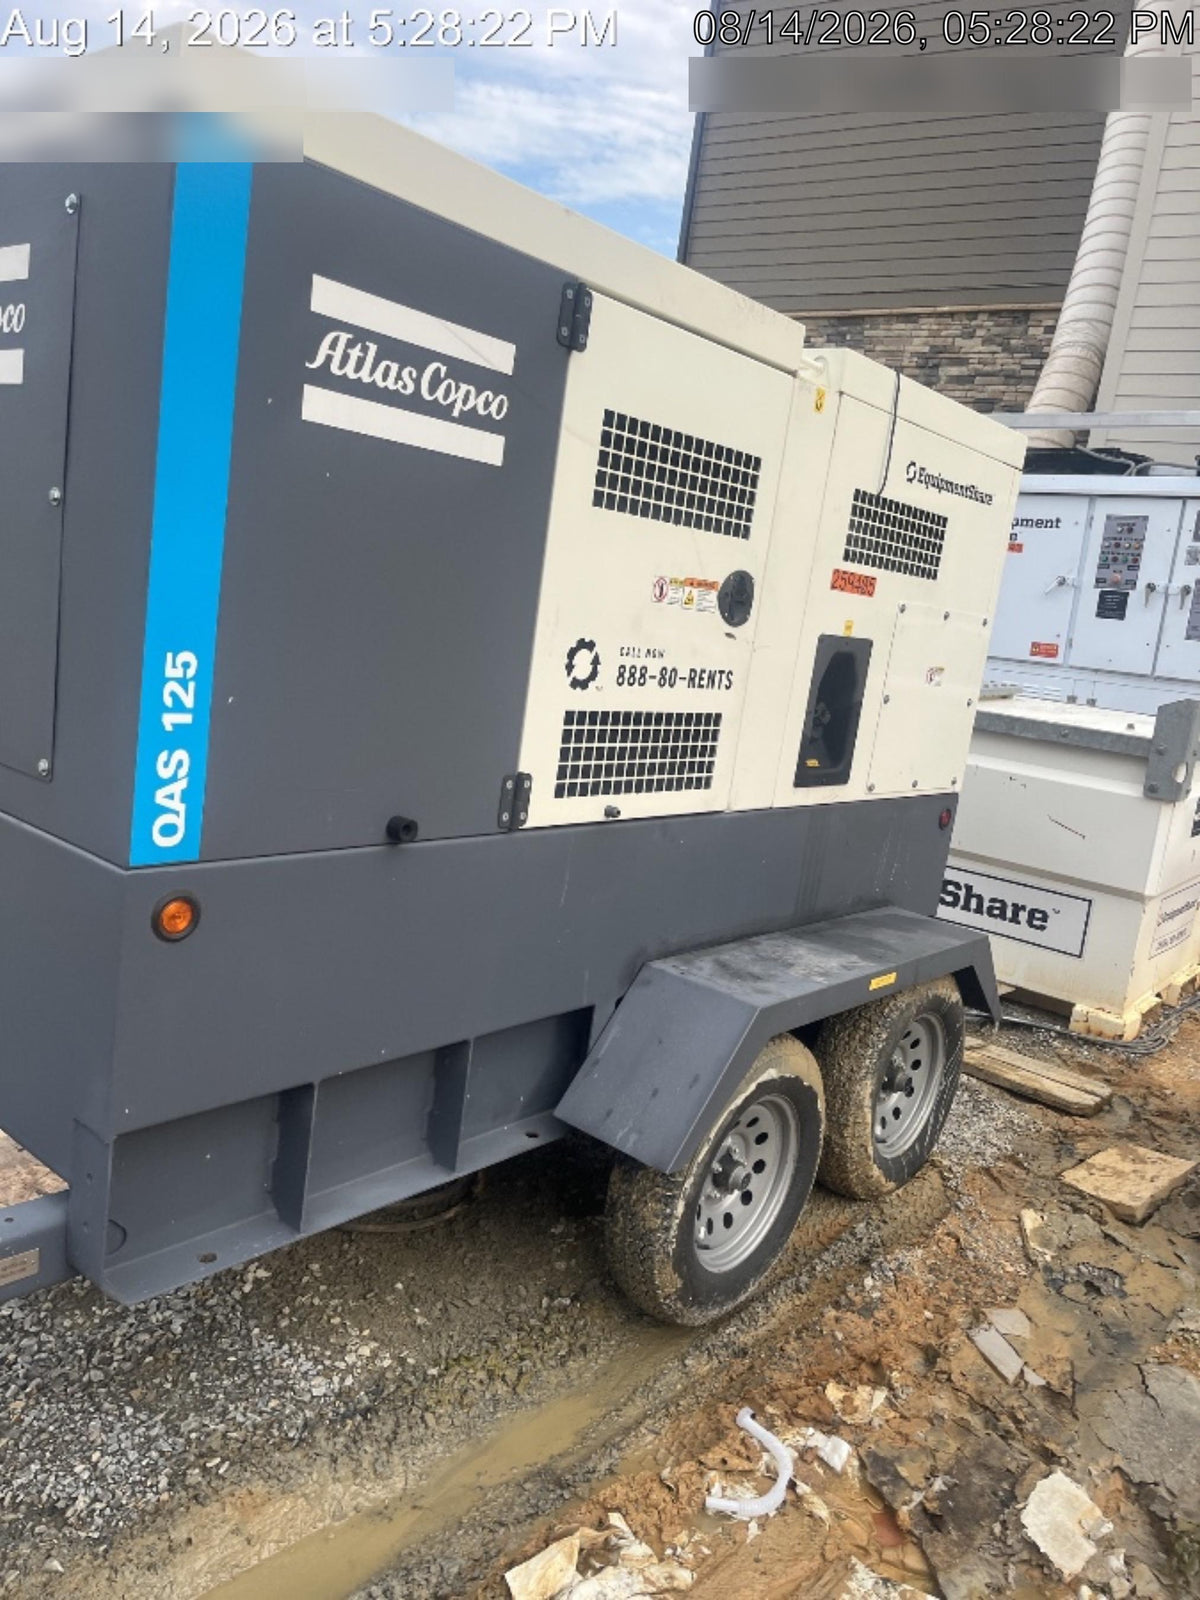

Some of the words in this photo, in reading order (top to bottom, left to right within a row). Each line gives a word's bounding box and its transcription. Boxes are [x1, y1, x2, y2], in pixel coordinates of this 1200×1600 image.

[0, 303, 26, 333] co
[305, 330, 417, 395] Atlas
[420, 362, 509, 420] Copco
[161, 650, 198, 732] 125
[616, 664, 734, 690] 888-80-RENTS
[152, 748, 190, 848] QAS
[939, 879, 1049, 932] Share
